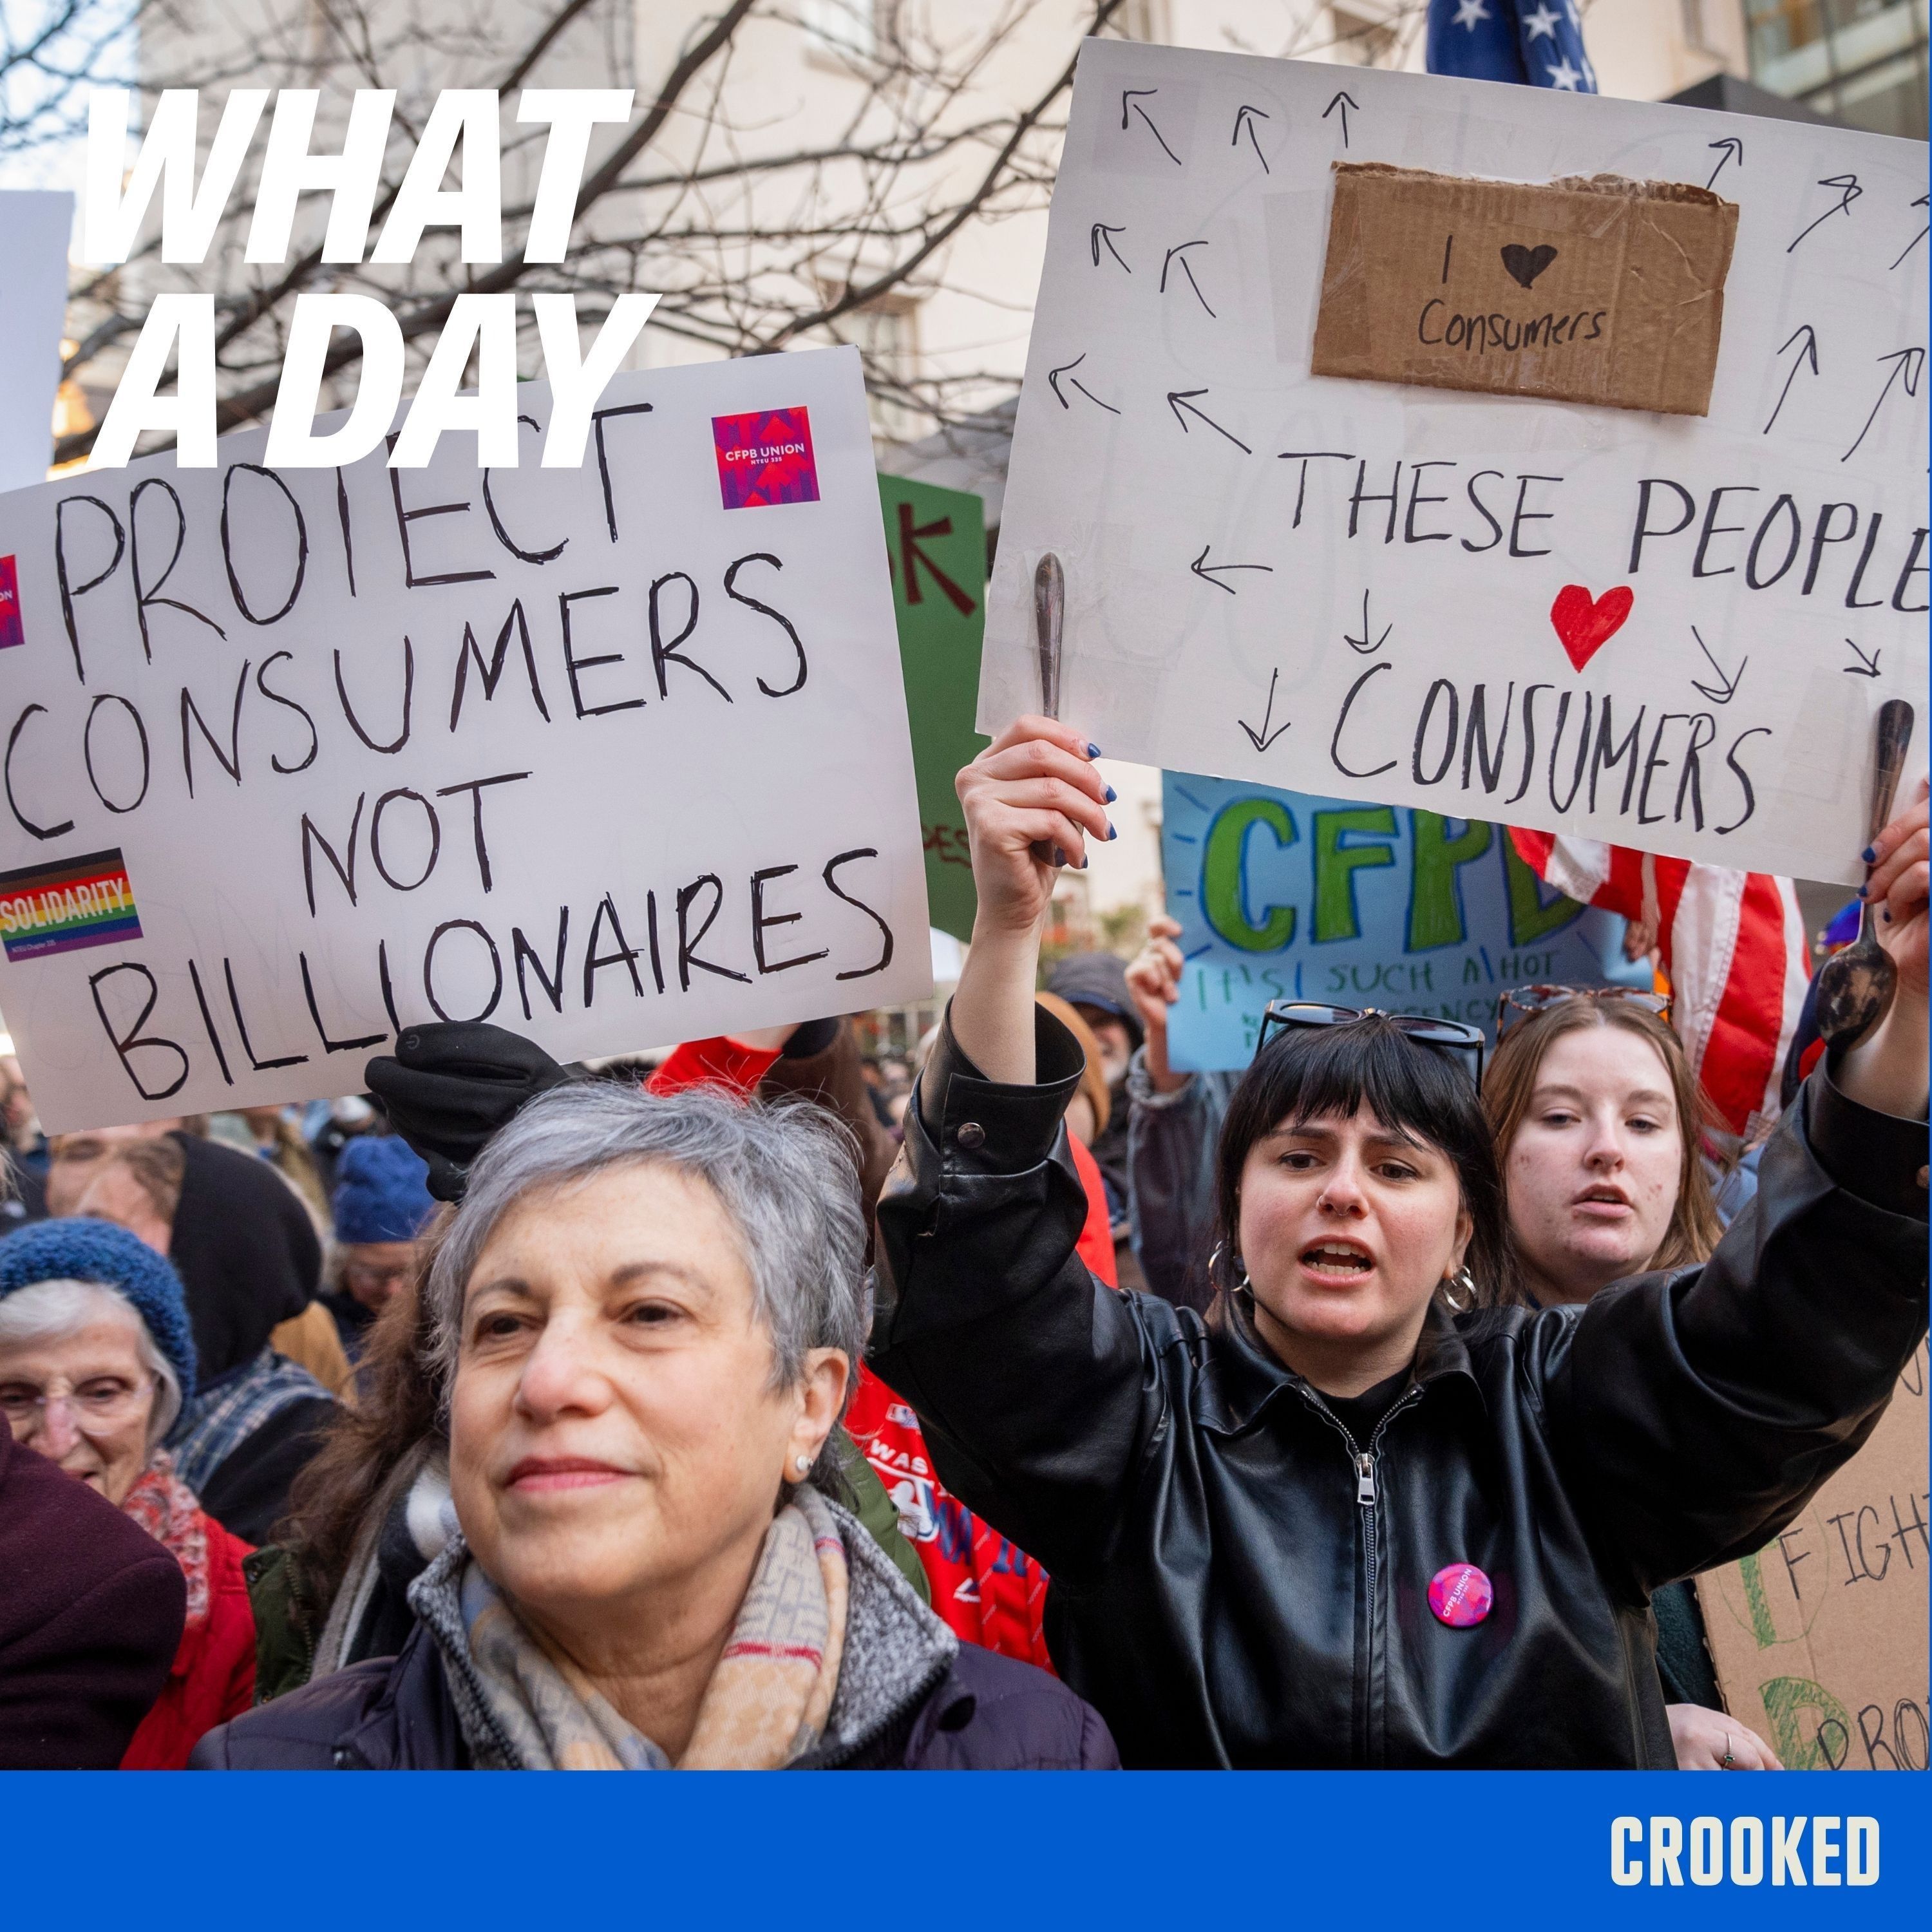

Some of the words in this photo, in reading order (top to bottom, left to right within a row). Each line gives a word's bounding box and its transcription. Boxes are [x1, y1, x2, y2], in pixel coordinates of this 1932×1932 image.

[1441, 234, 1453, 284] I
[1418, 299, 1607, 355] Consumers
[725, 449, 757, 461] CFPB
[761, 443, 805, 457] UNION
[1278, 452, 1564, 557] THESE
[1627, 479, 1929, 612] PEOPLE
[5, 553, 807, 840] CONSUMERS
[1331, 662, 1772, 835] CONSUMERS
[301, 771, 533, 918] NOT
[0, 878, 126, 933] SOLIDARITY
[88, 848, 893, 1101] BILLIONAIRES
[1325, 960, 1434, 994] SUCH
[1499, 949, 1564, 980] HOT
[869, 1439, 929, 1475] WAS
[1779, 1493, 1929, 1600] FIGH
[1443, 1596, 1457, 1617] CFPB
[1454, 1568, 1472, 1596] UNION
[1816, 1697, 1929, 1770] PRO
